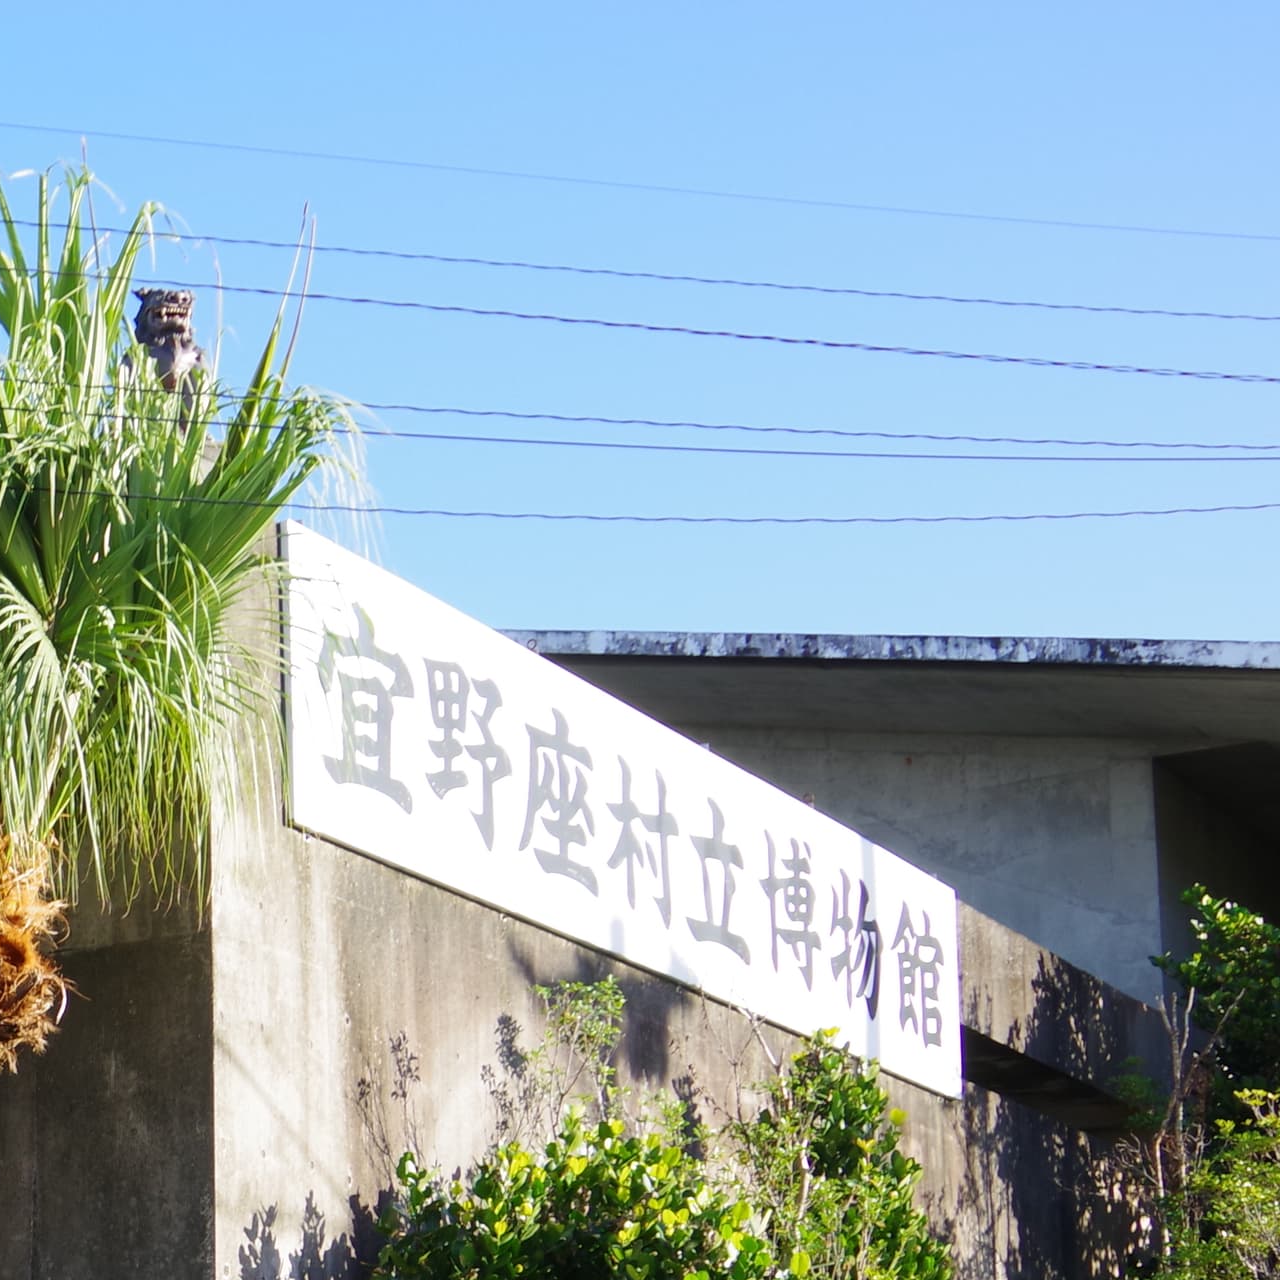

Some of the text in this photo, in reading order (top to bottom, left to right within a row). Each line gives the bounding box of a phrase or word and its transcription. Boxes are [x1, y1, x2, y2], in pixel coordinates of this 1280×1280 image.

[318, 602, 946, 1049] 宜野座村立博物館
